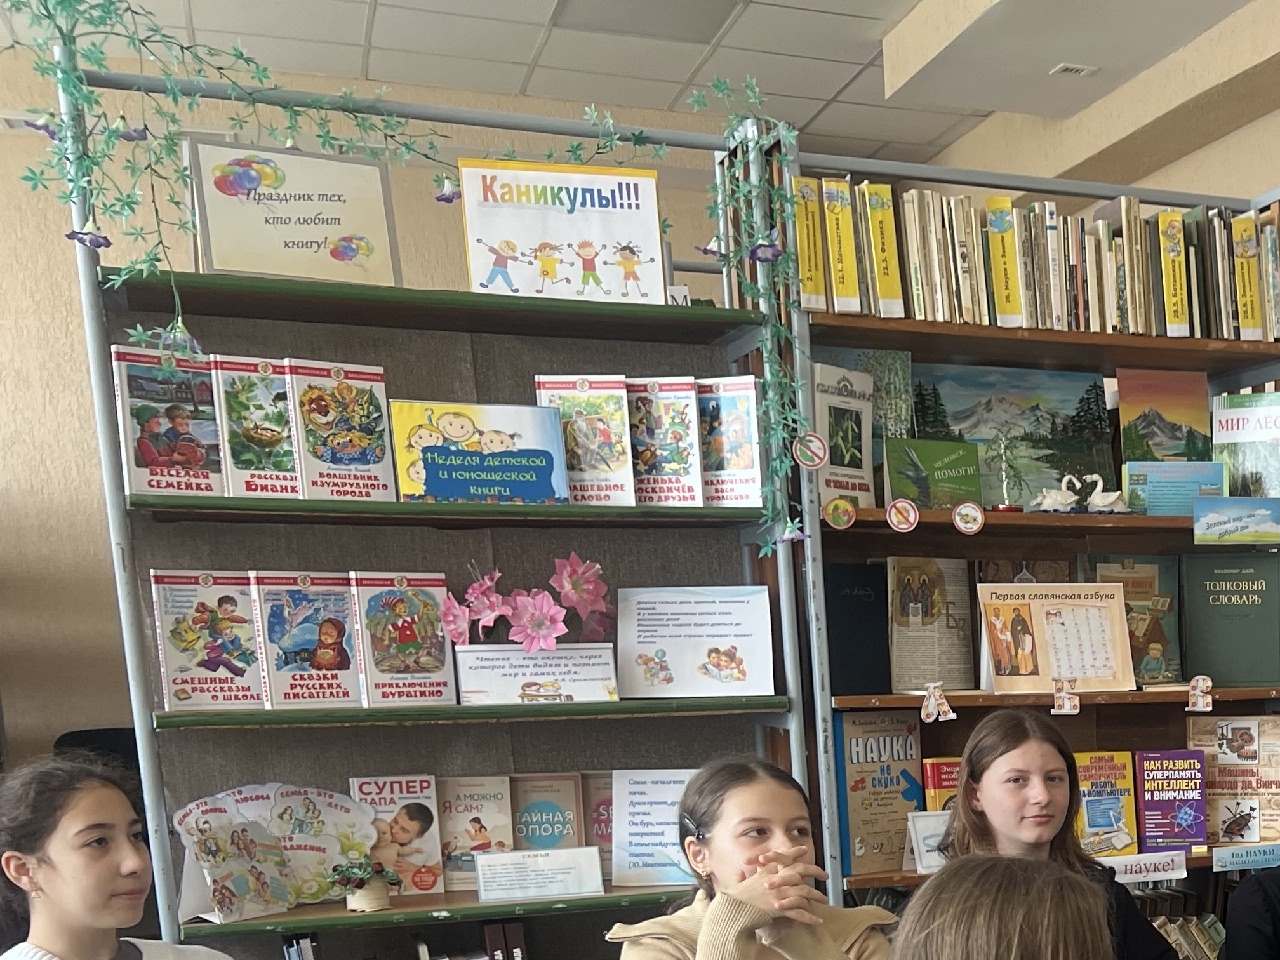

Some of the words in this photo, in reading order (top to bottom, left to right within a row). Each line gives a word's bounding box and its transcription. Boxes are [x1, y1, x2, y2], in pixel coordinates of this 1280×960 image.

[246, 189, 314, 204] Праздник
[317, 193, 347, 204] тех,
[480, 174, 641, 214] Каникулы!!!
[264, 215, 291, 225] кто
[294, 211, 341, 226] любит
[834, 216, 843, 264] Математика
[878, 220, 886, 254] Физика
[283, 237, 328, 253] книгу!
[1218, 417, 1249, 433] МИР
[425, 452, 480, 465] Неделя
[483, 456, 546, 466] детской
[318, 472, 380, 481] ВОЛШЕБНИК
[439, 470, 448, 478] и
[452, 470, 537, 481] юношеской
[934, 466, 976, 480] ПОМОГИ!
[147, 479, 213, 491] СЕМЕЙКА
[311, 480, 388, 491] ИЗУМРУДНОГО
[636, 477, 682, 485] ЖЕНЬКА
[330, 490, 371, 498] ГОРОДА
[634, 485, 695, 495] ОСКВИЧЁВ
[573, 494, 611, 502] СЛОВО
[638, 495, 654, 503] ЕГО
[656, 494, 696, 502] ДРУЗЬЯ
[1204, 580, 1266, 591] ТОЛКОВЫЙ
[990, 592, 1025, 601] Первая
[1083, 592, 1115, 601] азбука
[1209, 595, 1262, 605] СЛОВАРЬ
[172, 677, 236, 685] СМЕШНЫЕ
[291, 673, 339, 681] СКАЗКИ
[290, 682, 342, 690] РУССКИХ
[374, 681, 448, 689] ПРИКЛЮЧЕНИЯ
[283, 687, 350, 700] ПИСАТЕЛЕЙ
[381, 689, 443, 699] БУРАТИНО
[850, 735, 916, 764] НАУКА
[1090, 755, 1114, 764] САМЫЙ
[1078, 763, 1127, 772] СОВРЕМЕННЫЙ
[1144, 760, 1161, 770] КАК
[1164, 760, 1201, 769] РАЗВИТЬ
[1080, 773, 1126, 782] САМОУЧИТЕЛЬ
[1217, 767, 1259, 778] Машины
[358, 779, 431, 796] СУПЕР
[1090, 781, 1116, 789] РАБОТЫ
[1144, 780, 1201, 790] ИНТЕЛЛЕКТ
[1241, 781, 1253, 790] да
[455, 793, 462, 802] А
[463, 792, 504, 801] МОЖНО
[1088, 789, 1132, 798] КОМПЬЮТЕРЕ
[1145, 792, 1151, 800] И
[1154, 790, 1201, 800] ВНИМАНИЕ
[442, 801, 453, 814] Я
[455, 804, 484, 814] САМ?
[516, 809, 575, 822] ТАЙНАЯ
[515, 824, 575, 837] ОПОРА
[1245, 849, 1275, 858] НАУКИ
[1124, 858, 1175, 877] науке!
